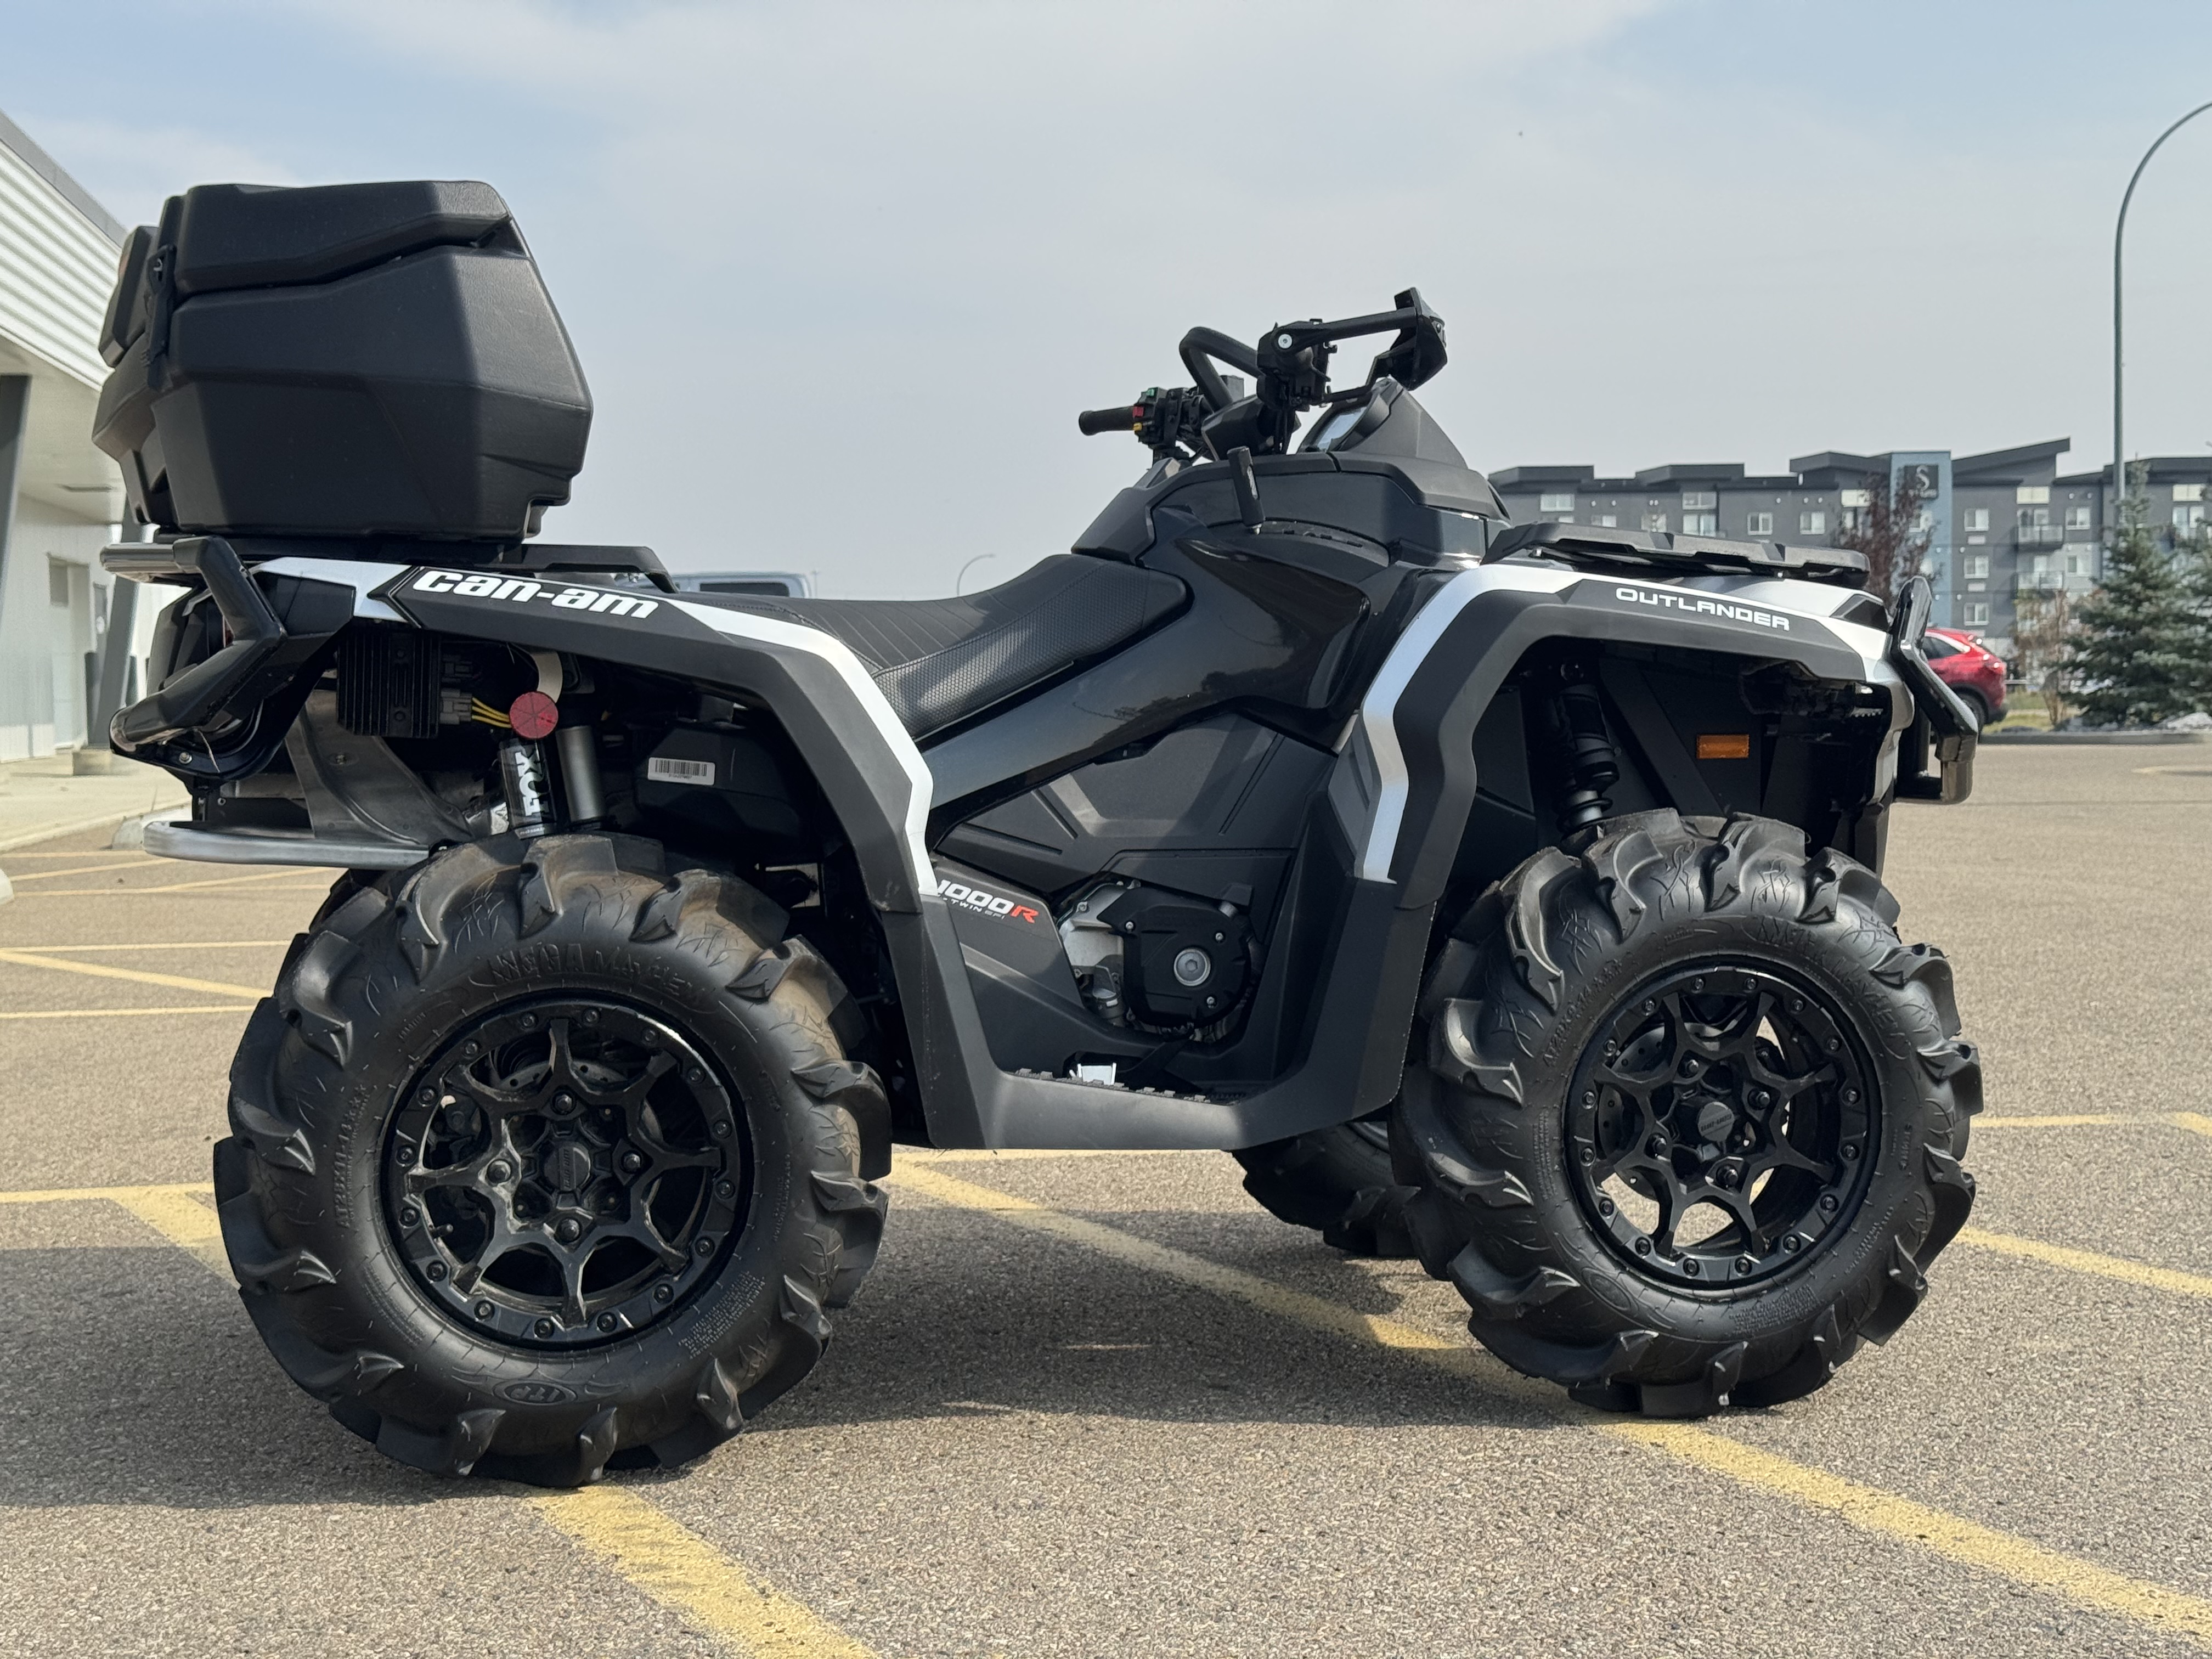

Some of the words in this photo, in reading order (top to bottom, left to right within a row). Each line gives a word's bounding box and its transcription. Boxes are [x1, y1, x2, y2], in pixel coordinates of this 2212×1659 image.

[1616, 588, 1790, 631] OUTLANDER
[515, 745, 550, 816] FOX
[938, 879, 1039, 923] 1000R
[510, 1380, 560, 1402] ITP
